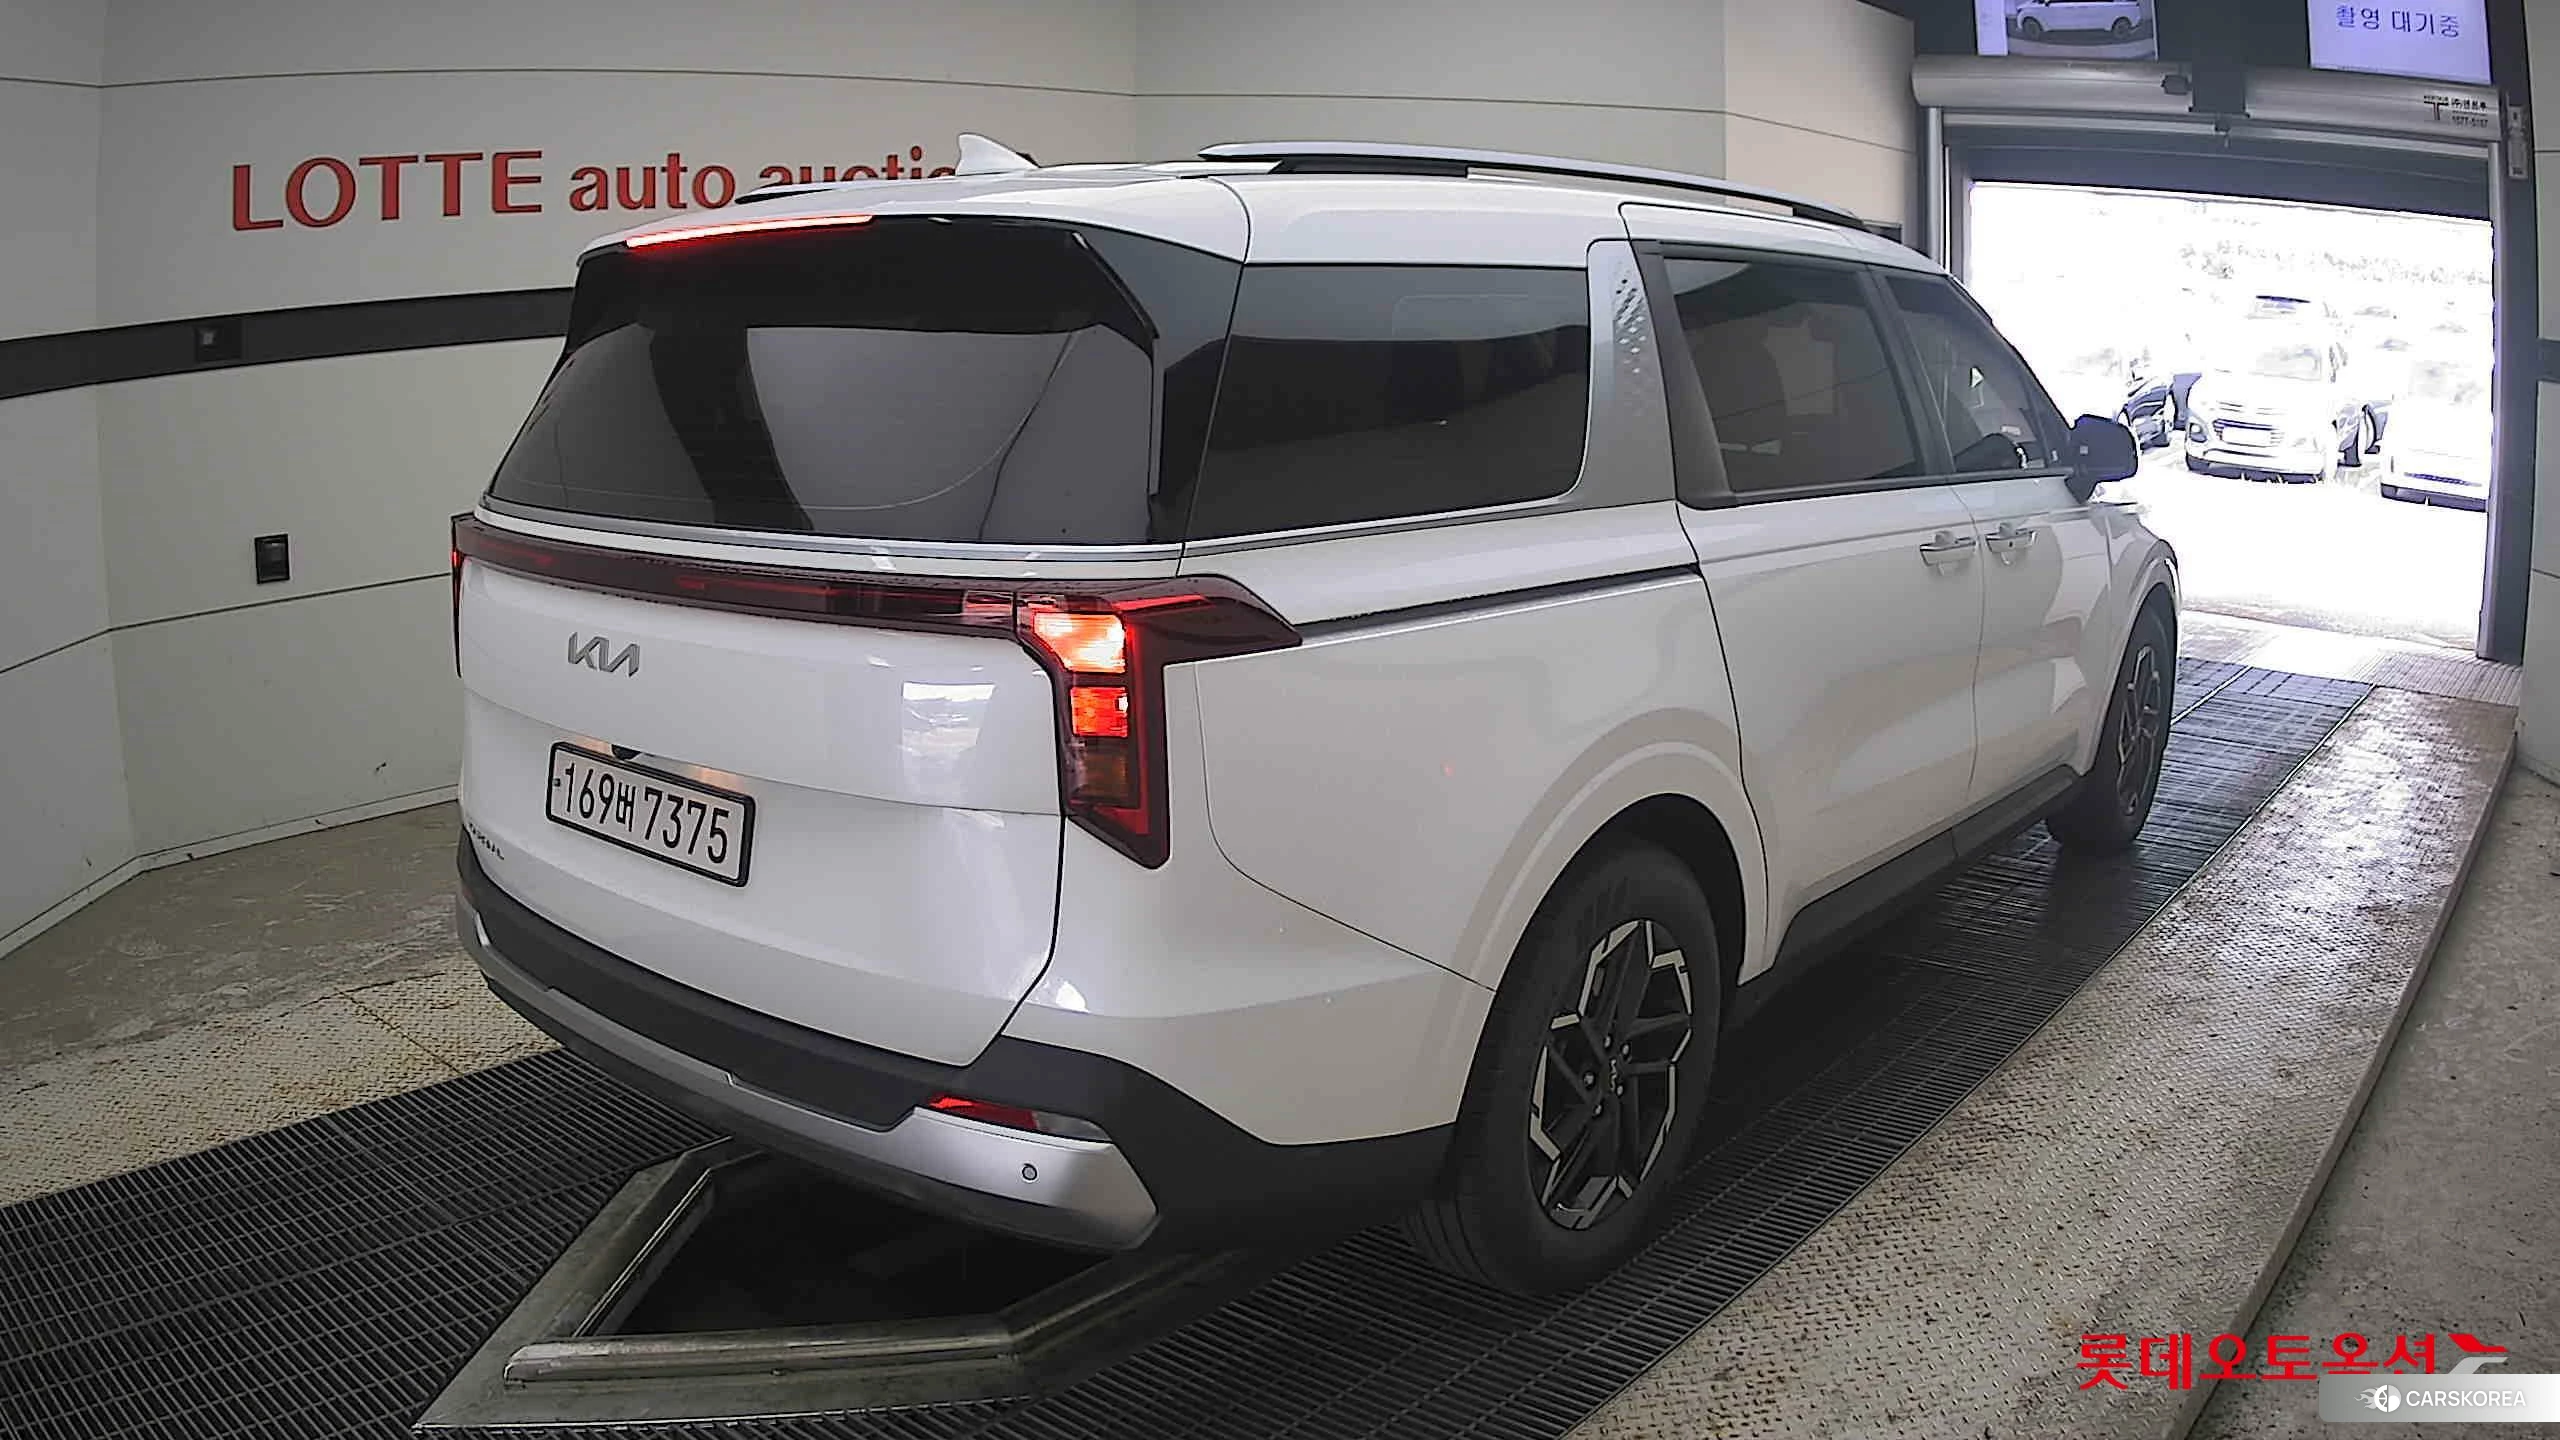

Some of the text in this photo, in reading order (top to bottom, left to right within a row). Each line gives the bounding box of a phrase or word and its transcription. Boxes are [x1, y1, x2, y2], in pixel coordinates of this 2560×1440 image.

[232, 150, 542, 231] LOTTE
[569, 152, 735, 211] auto
[644, 787, 730, 864] 7375
